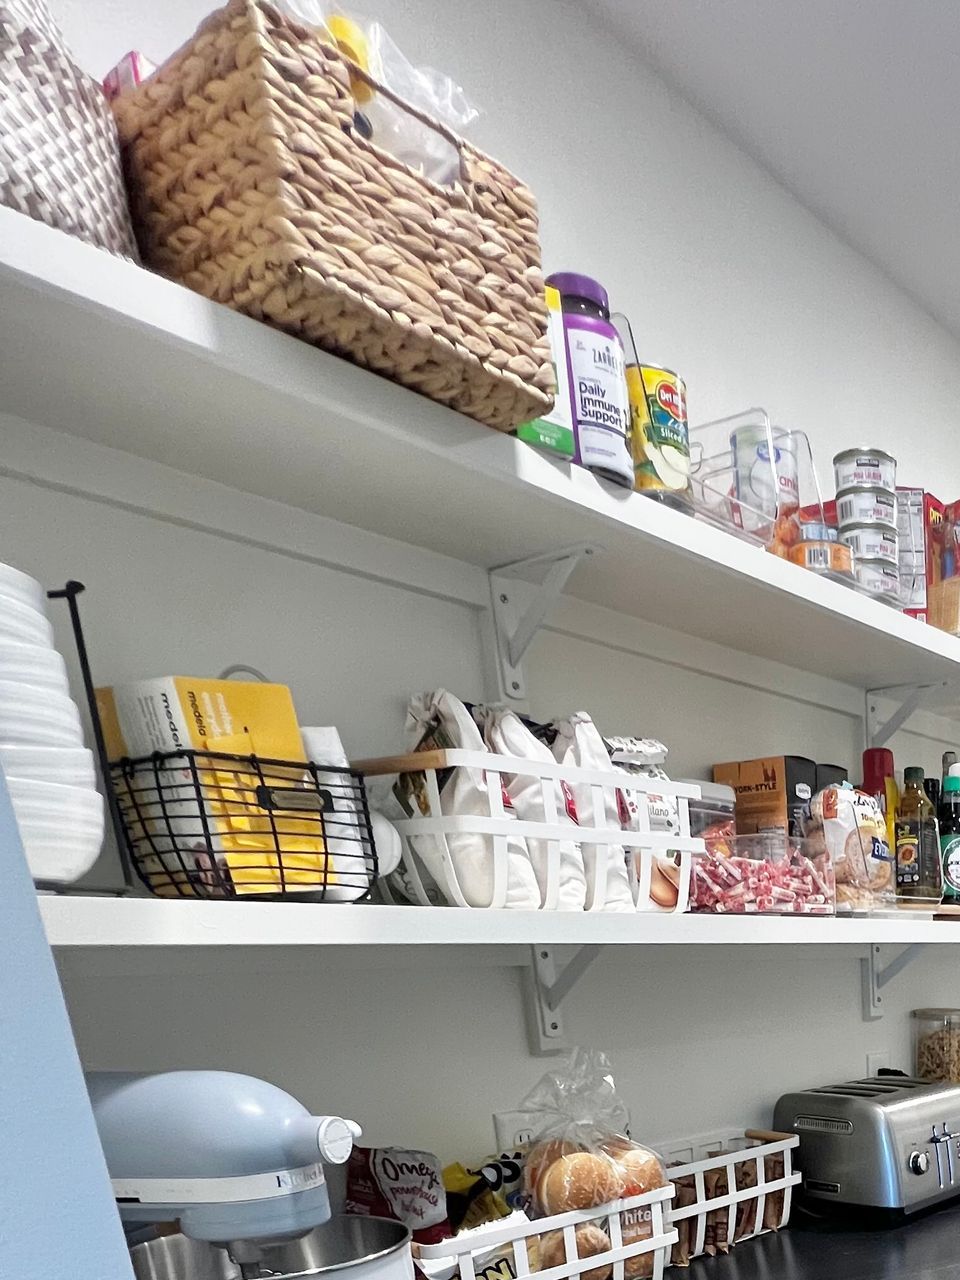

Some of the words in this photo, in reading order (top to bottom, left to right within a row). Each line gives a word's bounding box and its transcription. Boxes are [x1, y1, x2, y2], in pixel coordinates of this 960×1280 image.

[579, 381, 606, 398] Daily
[580, 395, 621, 416] Immune
[581, 407, 623, 429] Support
[161, 692, 184, 750] medel
[187, 690, 207, 737] medela
[621, 1209, 652, 1225] hite
